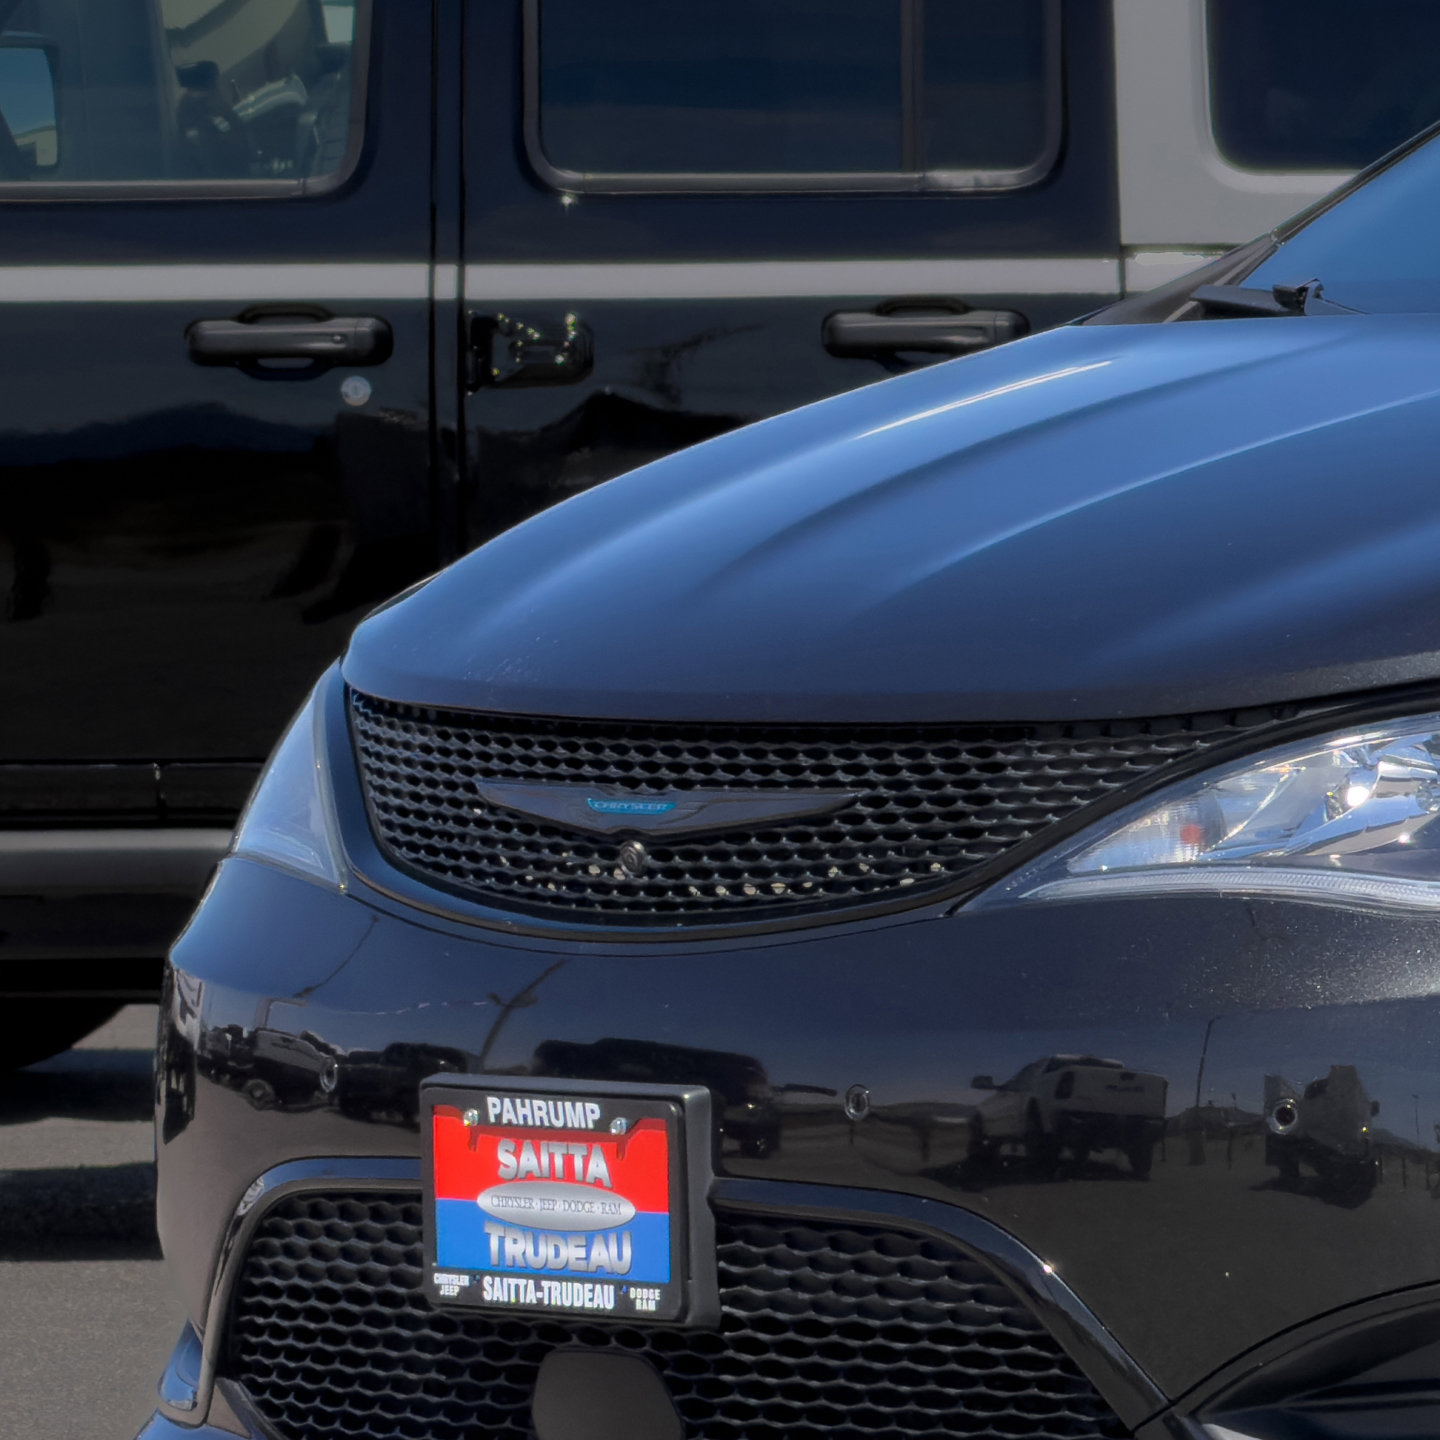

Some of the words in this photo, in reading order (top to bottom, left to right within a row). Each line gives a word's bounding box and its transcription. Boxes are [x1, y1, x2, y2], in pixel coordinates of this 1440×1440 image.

[486, 1095, 601, 1130] PAHRUMP
[496, 1139, 613, 1188] SAITTA
[490, 1195, 535, 1210] CHRYSLER
[538, 1197, 558, 1212] JEEP
[562, 1199, 596, 1214] DODGE
[600, 1201, 622, 1216] RAM
[483, 1221, 632, 1276] TRUDEAU
[433, 1272, 470, 1287] CHRYSLER
[439, 1284, 460, 1297] JEEP
[482, 1275, 615, 1310] SAITTA-TRUDEAU
[629, 1287, 661, 1301] DODGE
[635, 1298, 657, 1312] RAM
